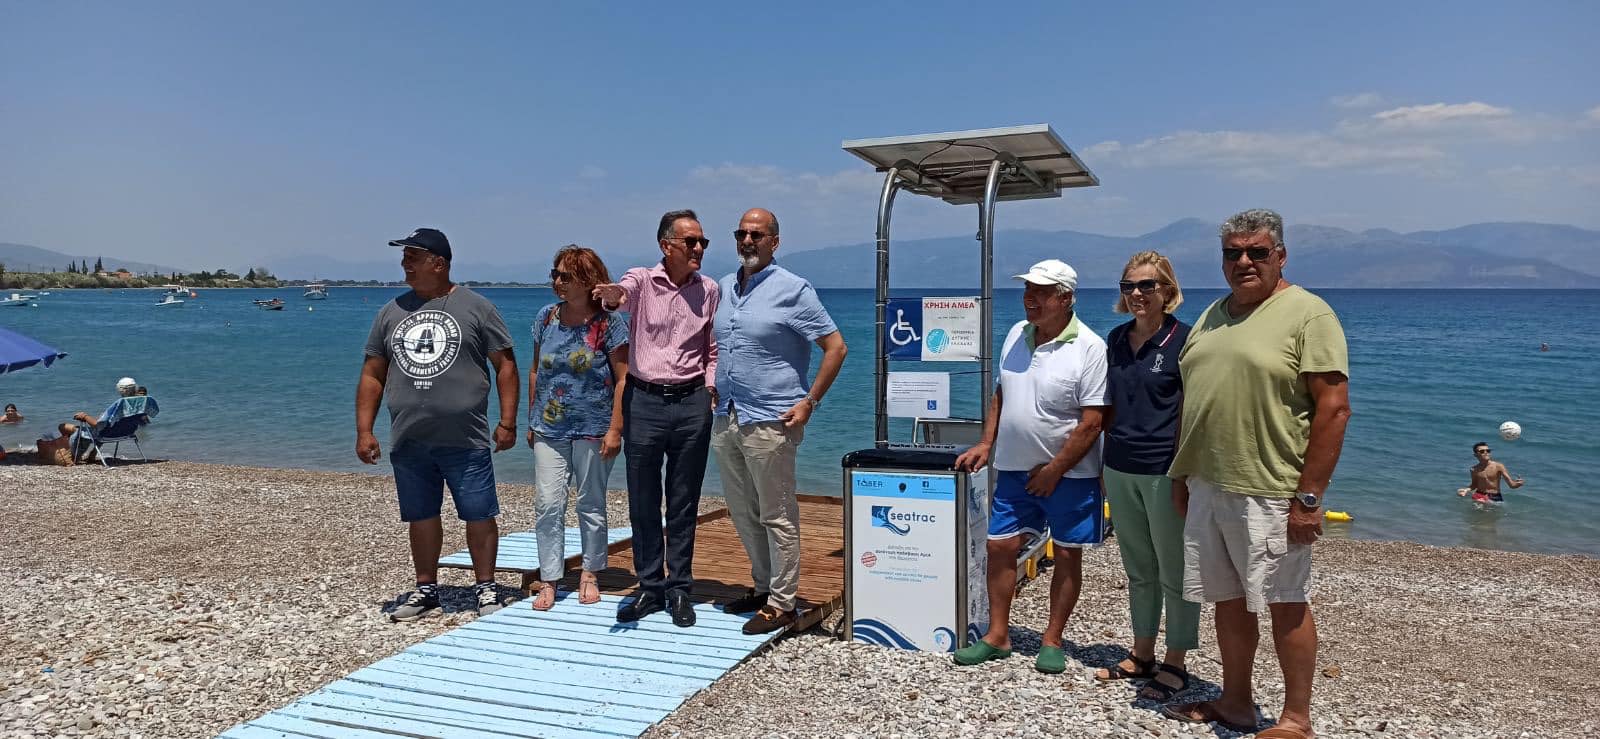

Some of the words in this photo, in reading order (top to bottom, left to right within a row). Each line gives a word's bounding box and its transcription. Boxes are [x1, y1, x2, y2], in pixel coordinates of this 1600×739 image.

[924, 301, 949, 309] ΧΡΗΣΗ
[951, 301, 975, 309] ΑΜΕΑ
[890, 512, 936, 523] seatrac
